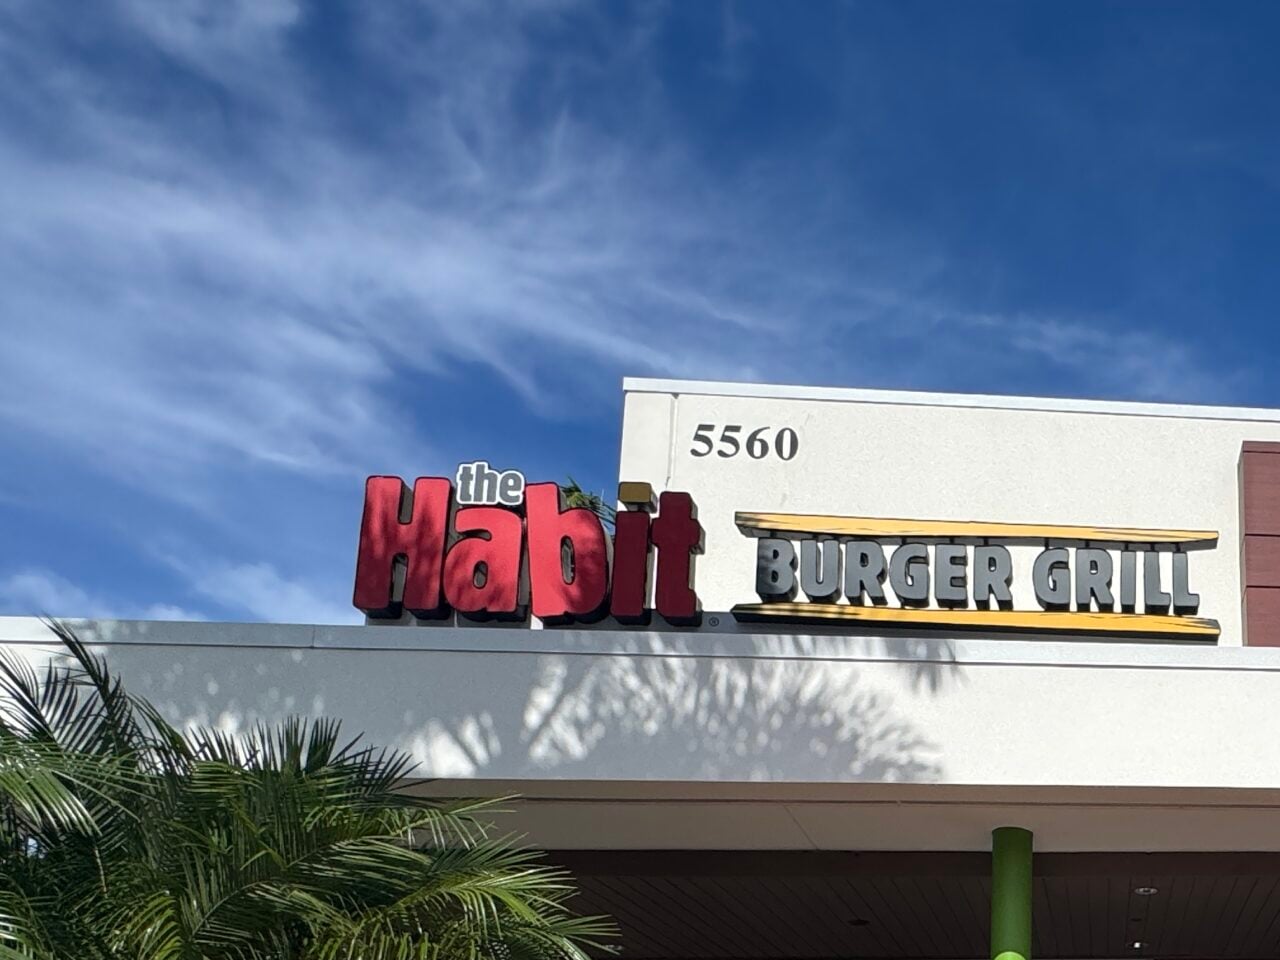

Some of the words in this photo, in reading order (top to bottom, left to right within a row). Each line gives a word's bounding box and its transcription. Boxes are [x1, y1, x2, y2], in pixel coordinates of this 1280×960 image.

[691, 424, 798, 461] 5560
[456, 461, 525, 505] the
[353, 475, 705, 626] Habit
[756, 537, 1013, 611] BURGER
[1032, 546, 1199, 616] GRILL
